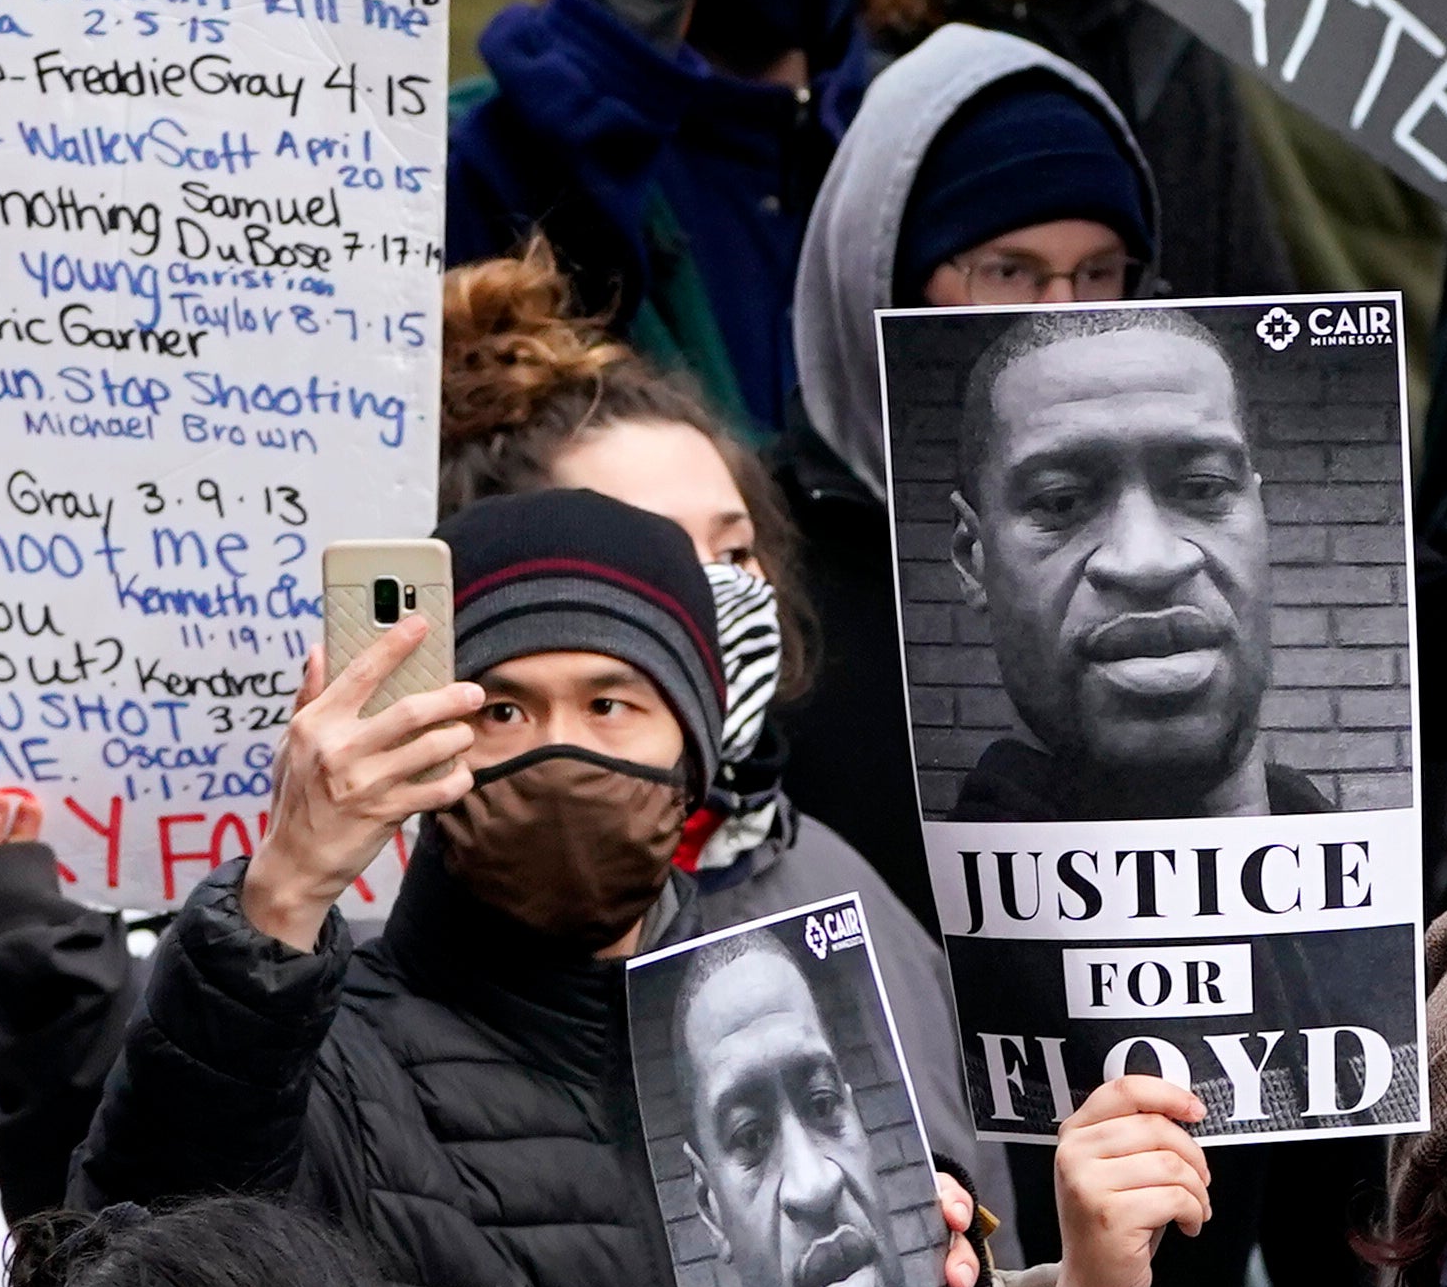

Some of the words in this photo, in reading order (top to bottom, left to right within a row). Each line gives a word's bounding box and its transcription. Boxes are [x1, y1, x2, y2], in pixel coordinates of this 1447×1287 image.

[1308, 307, 1391, 336] CAIR
[1310, 333, 1393, 347] MINNESOTA
[152, 528, 249, 575] me
[39, 692, 192, 744] SHOT
[957, 838, 1375, 934] JUSTICE
[824, 907, 862, 941] CAIR
[1088, 957, 1227, 1008] FOR
